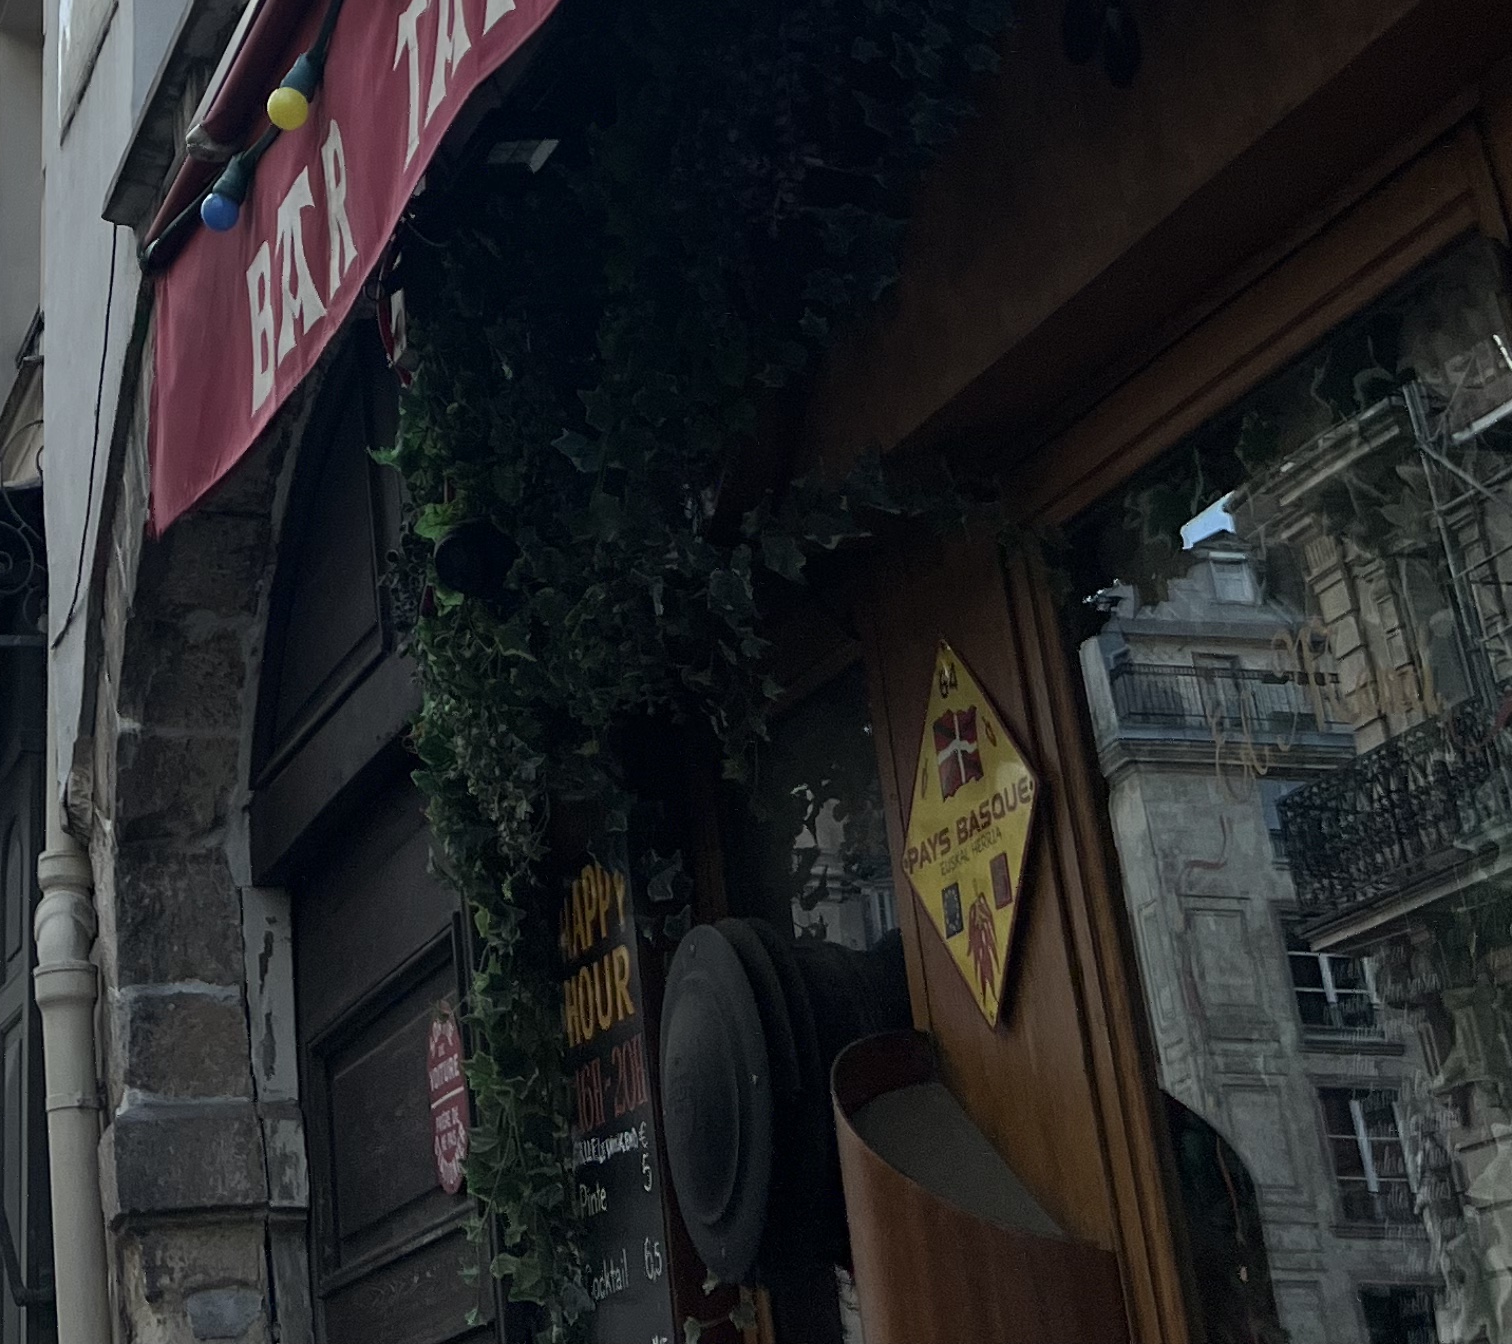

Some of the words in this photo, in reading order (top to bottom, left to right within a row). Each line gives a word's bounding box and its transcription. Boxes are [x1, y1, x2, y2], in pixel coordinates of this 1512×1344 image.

[246, 118, 359, 417] BAR
[907, 826, 951, 875] PAYS
[956, 775, 1031, 845] BASQUE
[564, 944, 635, 1049] HOUR
[579, 1181, 607, 1219] Pinte
[642, 1153, 652, 1192] 5
[587, 1248, 628, 1301] ocktail
